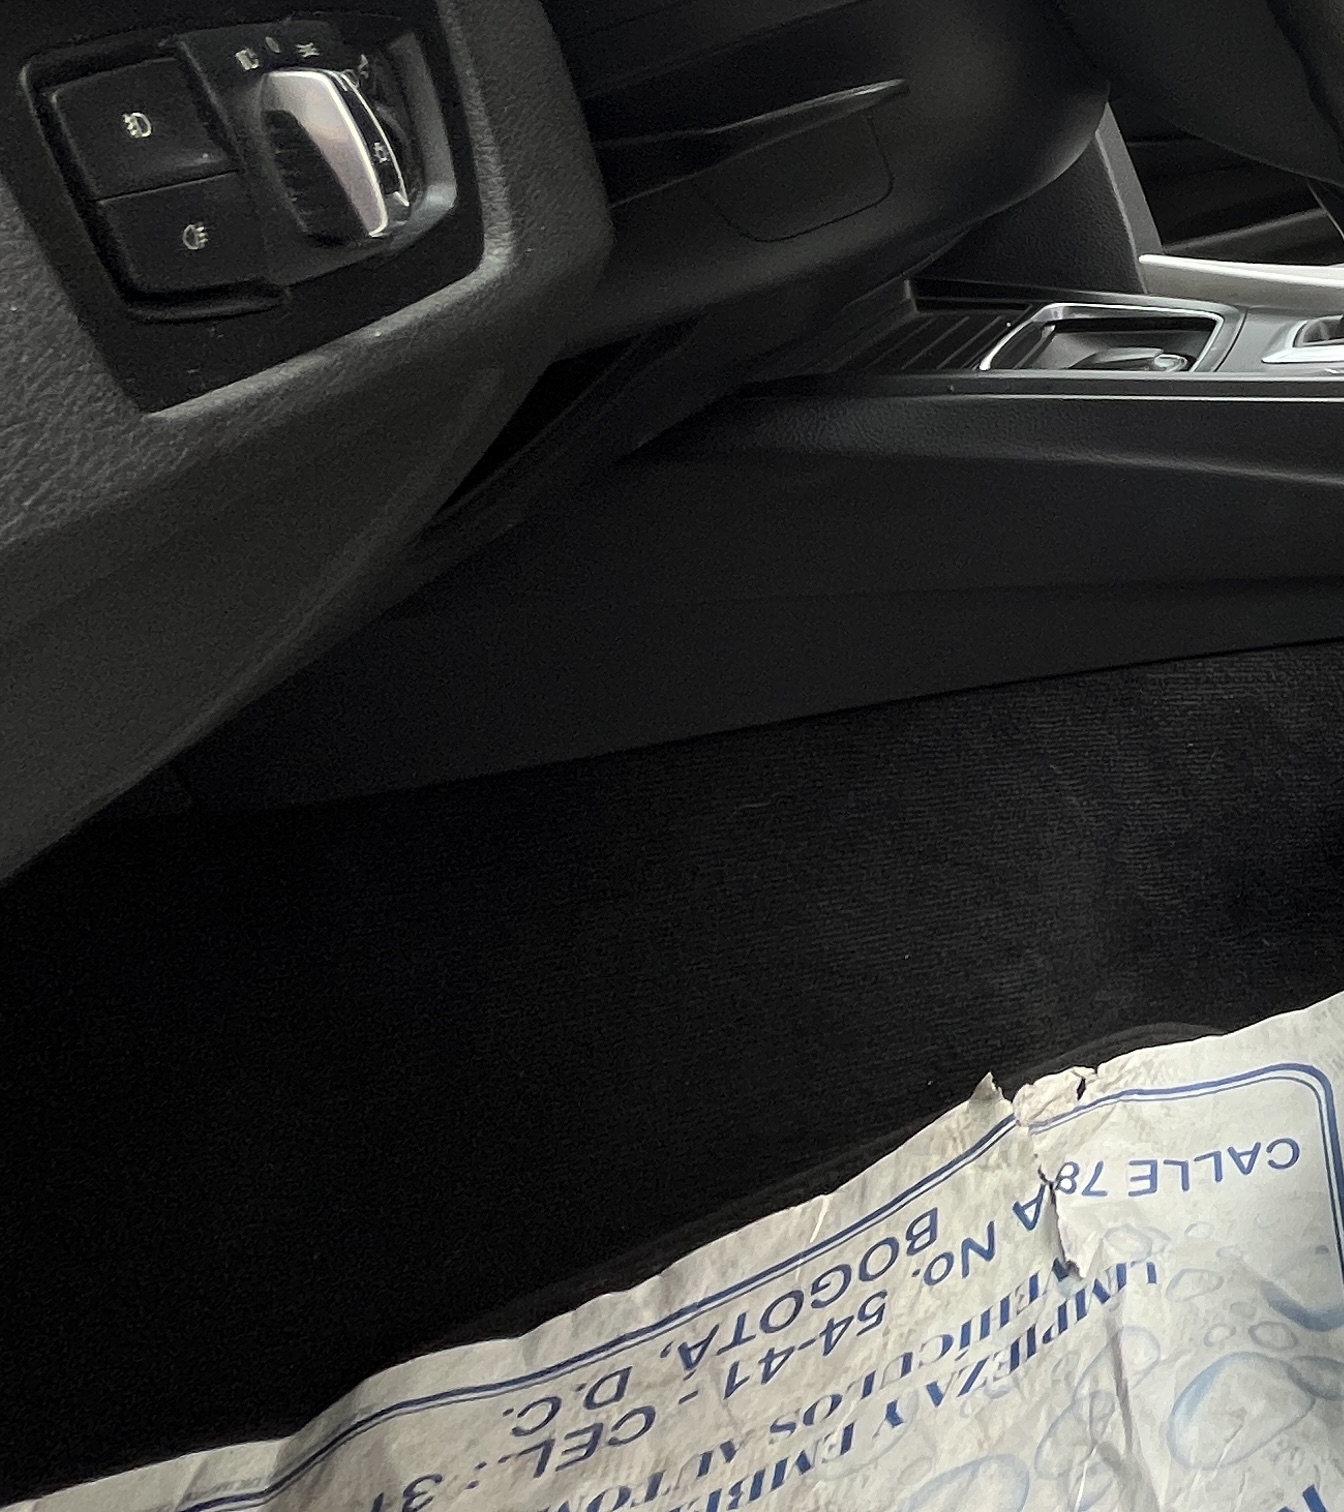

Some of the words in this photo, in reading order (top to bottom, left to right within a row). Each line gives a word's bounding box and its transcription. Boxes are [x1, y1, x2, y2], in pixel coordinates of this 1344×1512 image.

[1128, 1137, 1301, 1198] CALLE
[723, 1288, 888, 1400] 54-41
[925, 1260, 1158, 1408] LIMPIEZA
